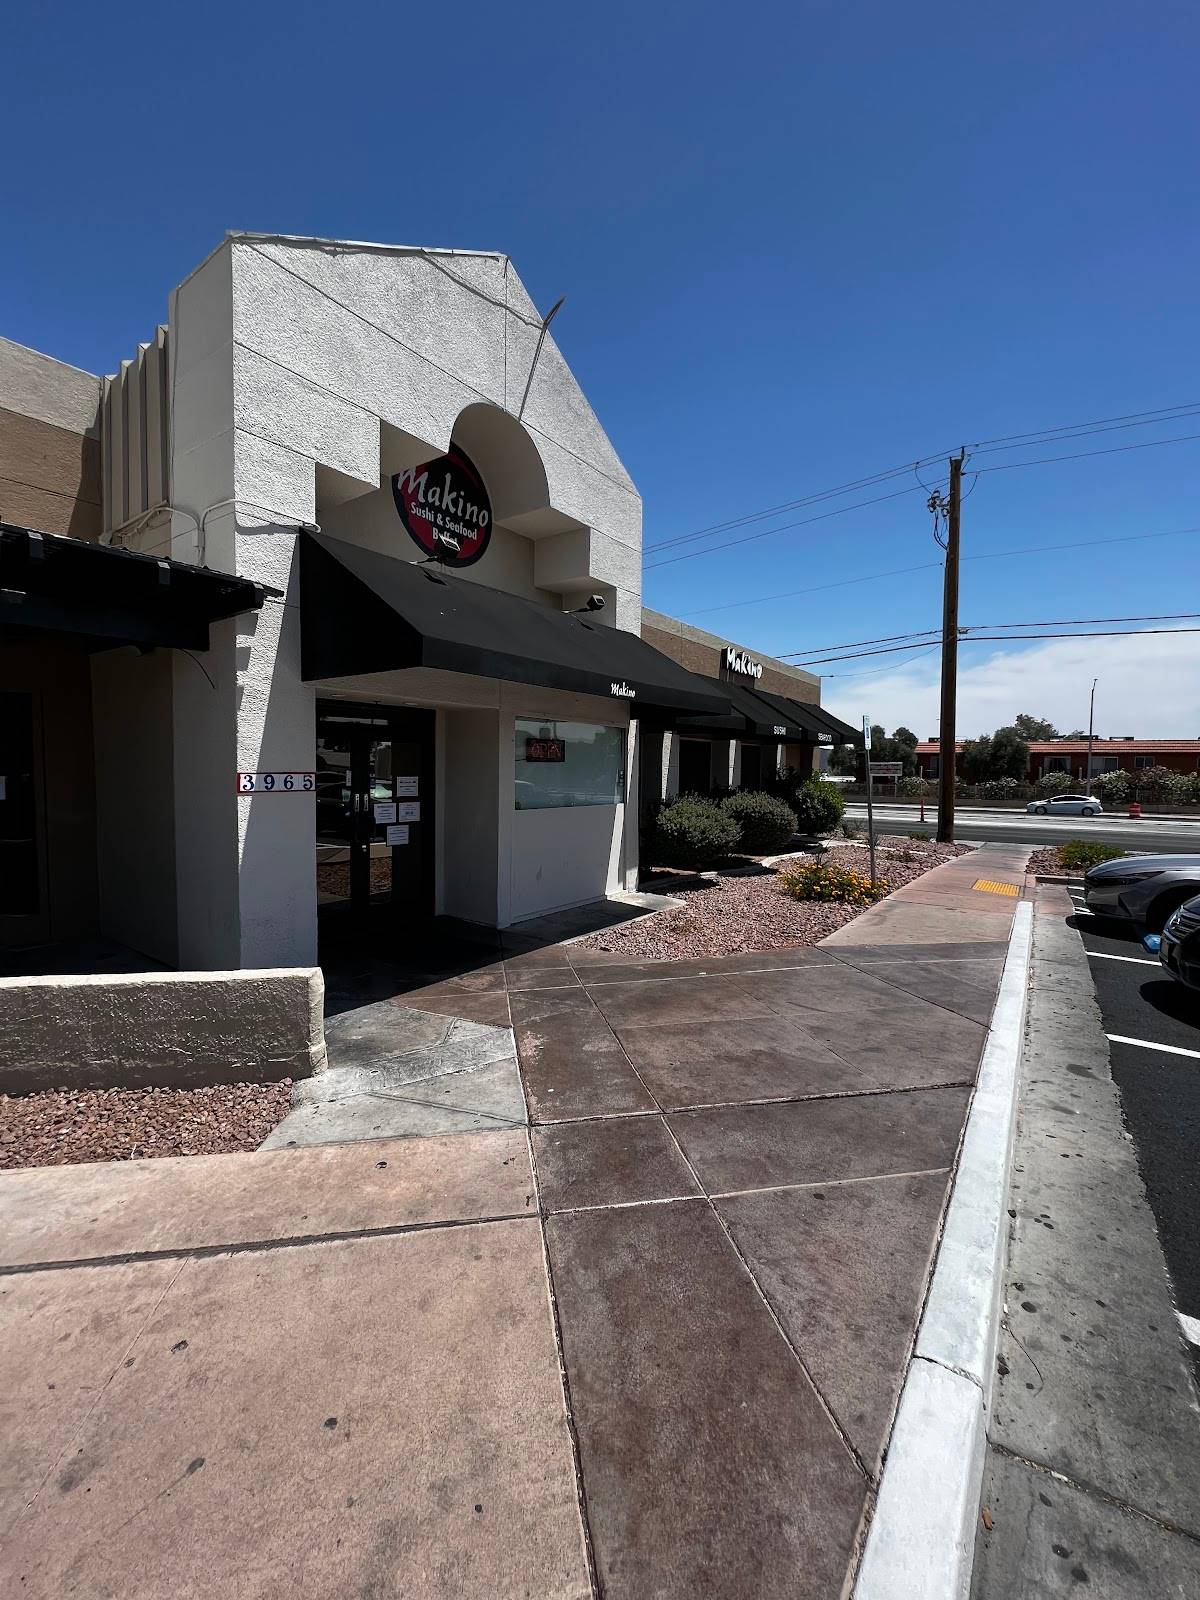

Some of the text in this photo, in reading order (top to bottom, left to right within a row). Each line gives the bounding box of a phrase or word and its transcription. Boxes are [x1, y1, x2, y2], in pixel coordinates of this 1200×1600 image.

[397, 468, 489, 527] Makino
[411, 502, 478, 540] Sushi & Seafood
[726, 645, 763, 679] Makino
[610, 681, 636, 698] Makino
[773, 725, 787, 735] SUSHI
[242, 774, 313, 790] 3965
